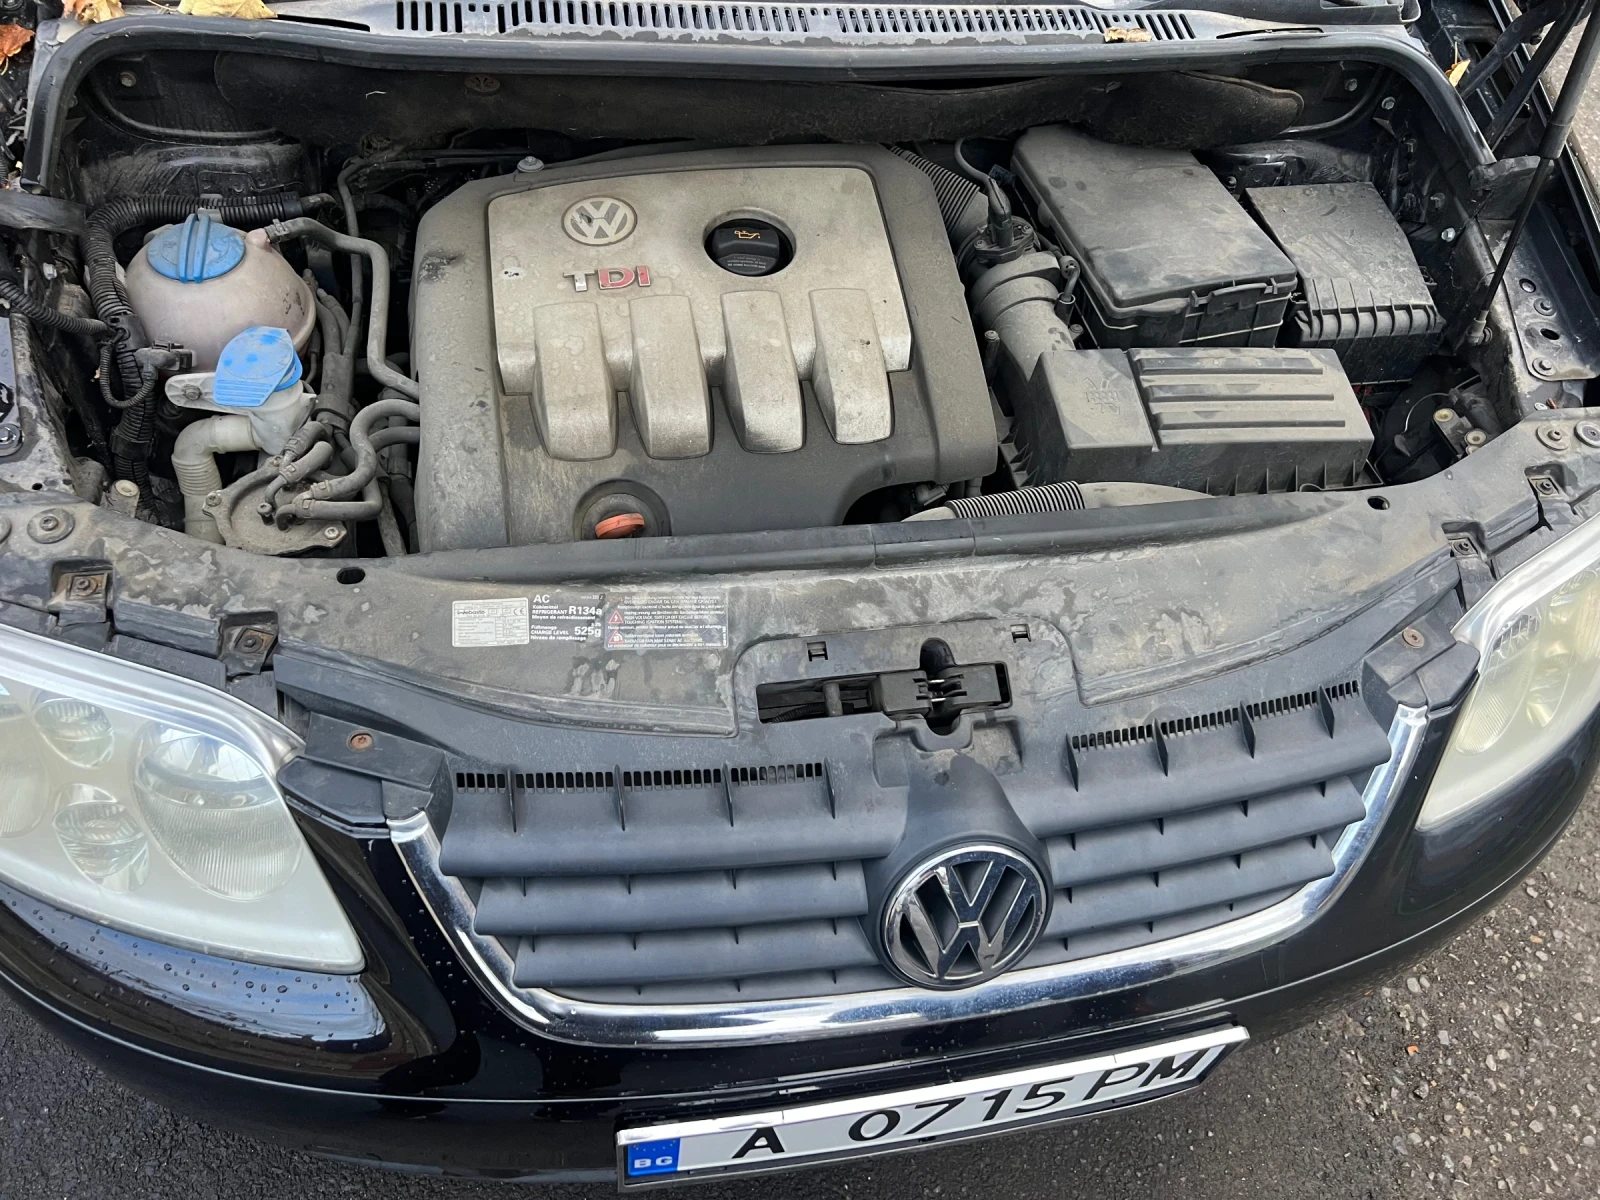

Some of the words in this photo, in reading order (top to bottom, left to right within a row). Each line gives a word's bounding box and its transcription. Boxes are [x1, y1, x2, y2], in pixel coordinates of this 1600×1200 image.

[563, 265, 651, 292] TDI
[533, 594, 550, 604] AC
[568, 605, 603, 616] R134a
[574, 626, 602, 638] 525g
[884, 845, 1046, 988] VW
[731, 1126, 785, 1160] A
[848, 1078, 1075, 1142] 0715
[1083, 1051, 1209, 1101] PM
[634, 1156, 673, 1169] BG
